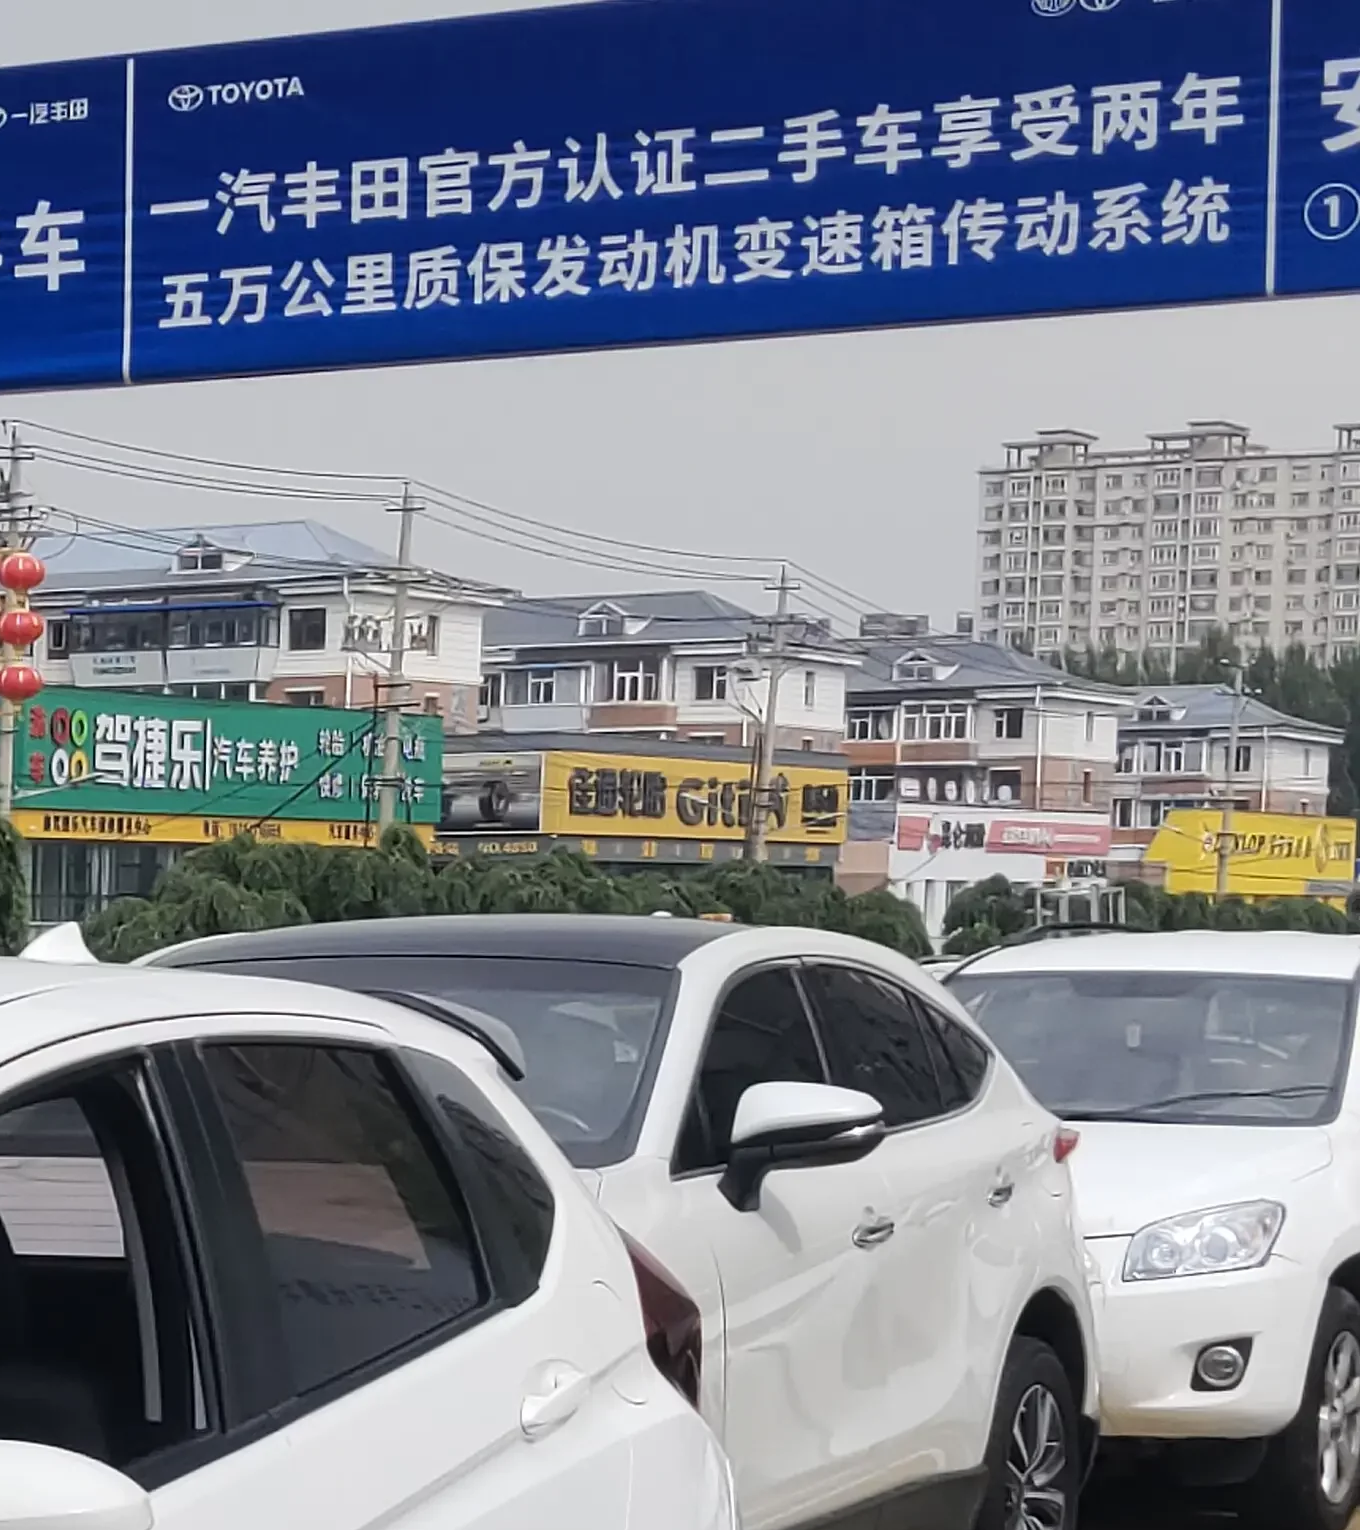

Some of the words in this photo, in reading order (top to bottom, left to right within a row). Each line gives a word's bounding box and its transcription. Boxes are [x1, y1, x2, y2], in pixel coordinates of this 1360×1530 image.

[207, 76, 304, 105] TOYOTA
[150, 72, 1244, 234] 一汽丰田官方认证二手车享受两年
[158, 176, 1230, 329] 五万公里质保发动机变速箱传动系统
[212, 733, 300, 785] 汽车养护
